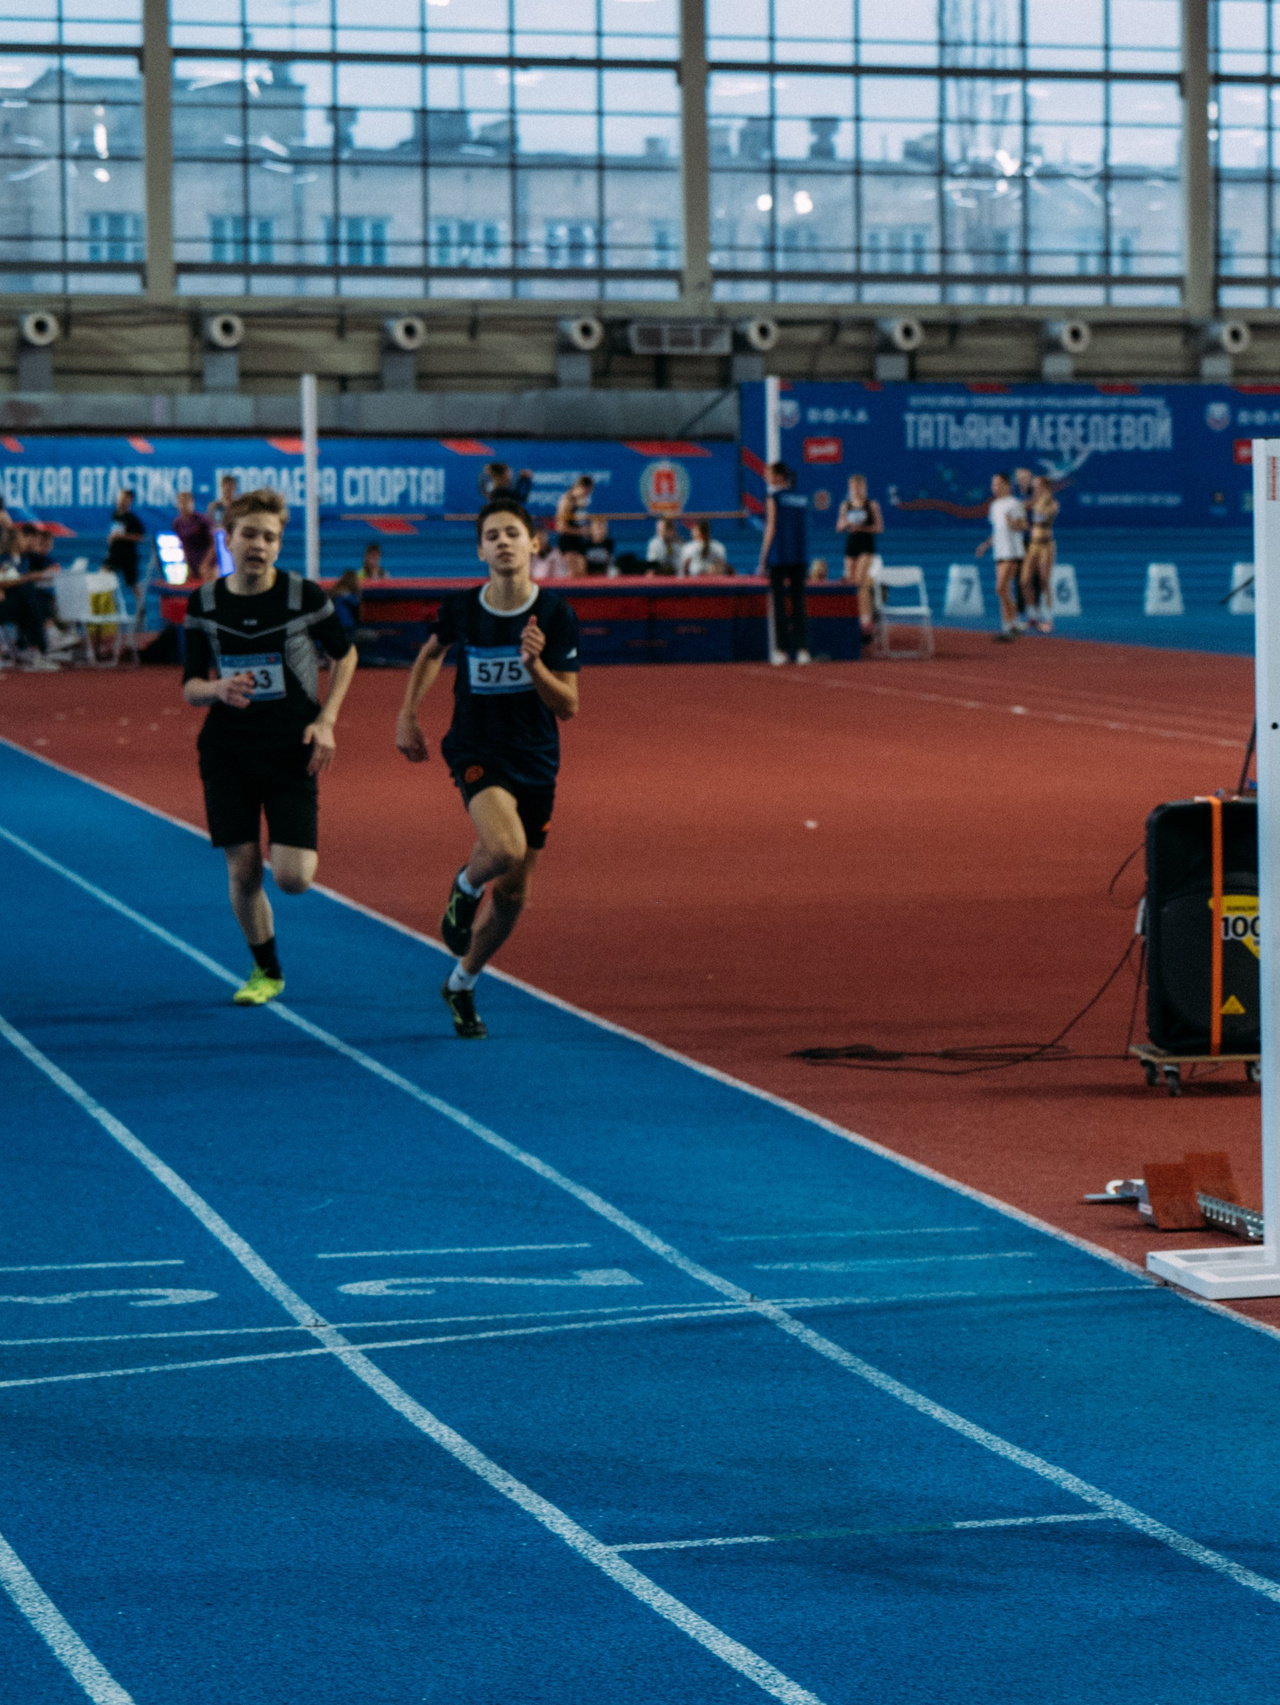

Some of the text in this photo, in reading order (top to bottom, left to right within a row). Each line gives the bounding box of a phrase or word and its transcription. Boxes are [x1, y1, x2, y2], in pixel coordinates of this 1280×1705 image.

[904, 405, 1173, 452] ТАТЬЯНЫ ЛЕБЕДЕВОЙ
[0, 466, 73, 507] ЕГКАЯ
[343, 466, 446, 507] СПОРТА!
[960, 578, 975, 603] 7
[1056, 579, 1072, 604] 6
[1158, 576, 1174, 602] 5
[478, 661, 522, 683] 575
